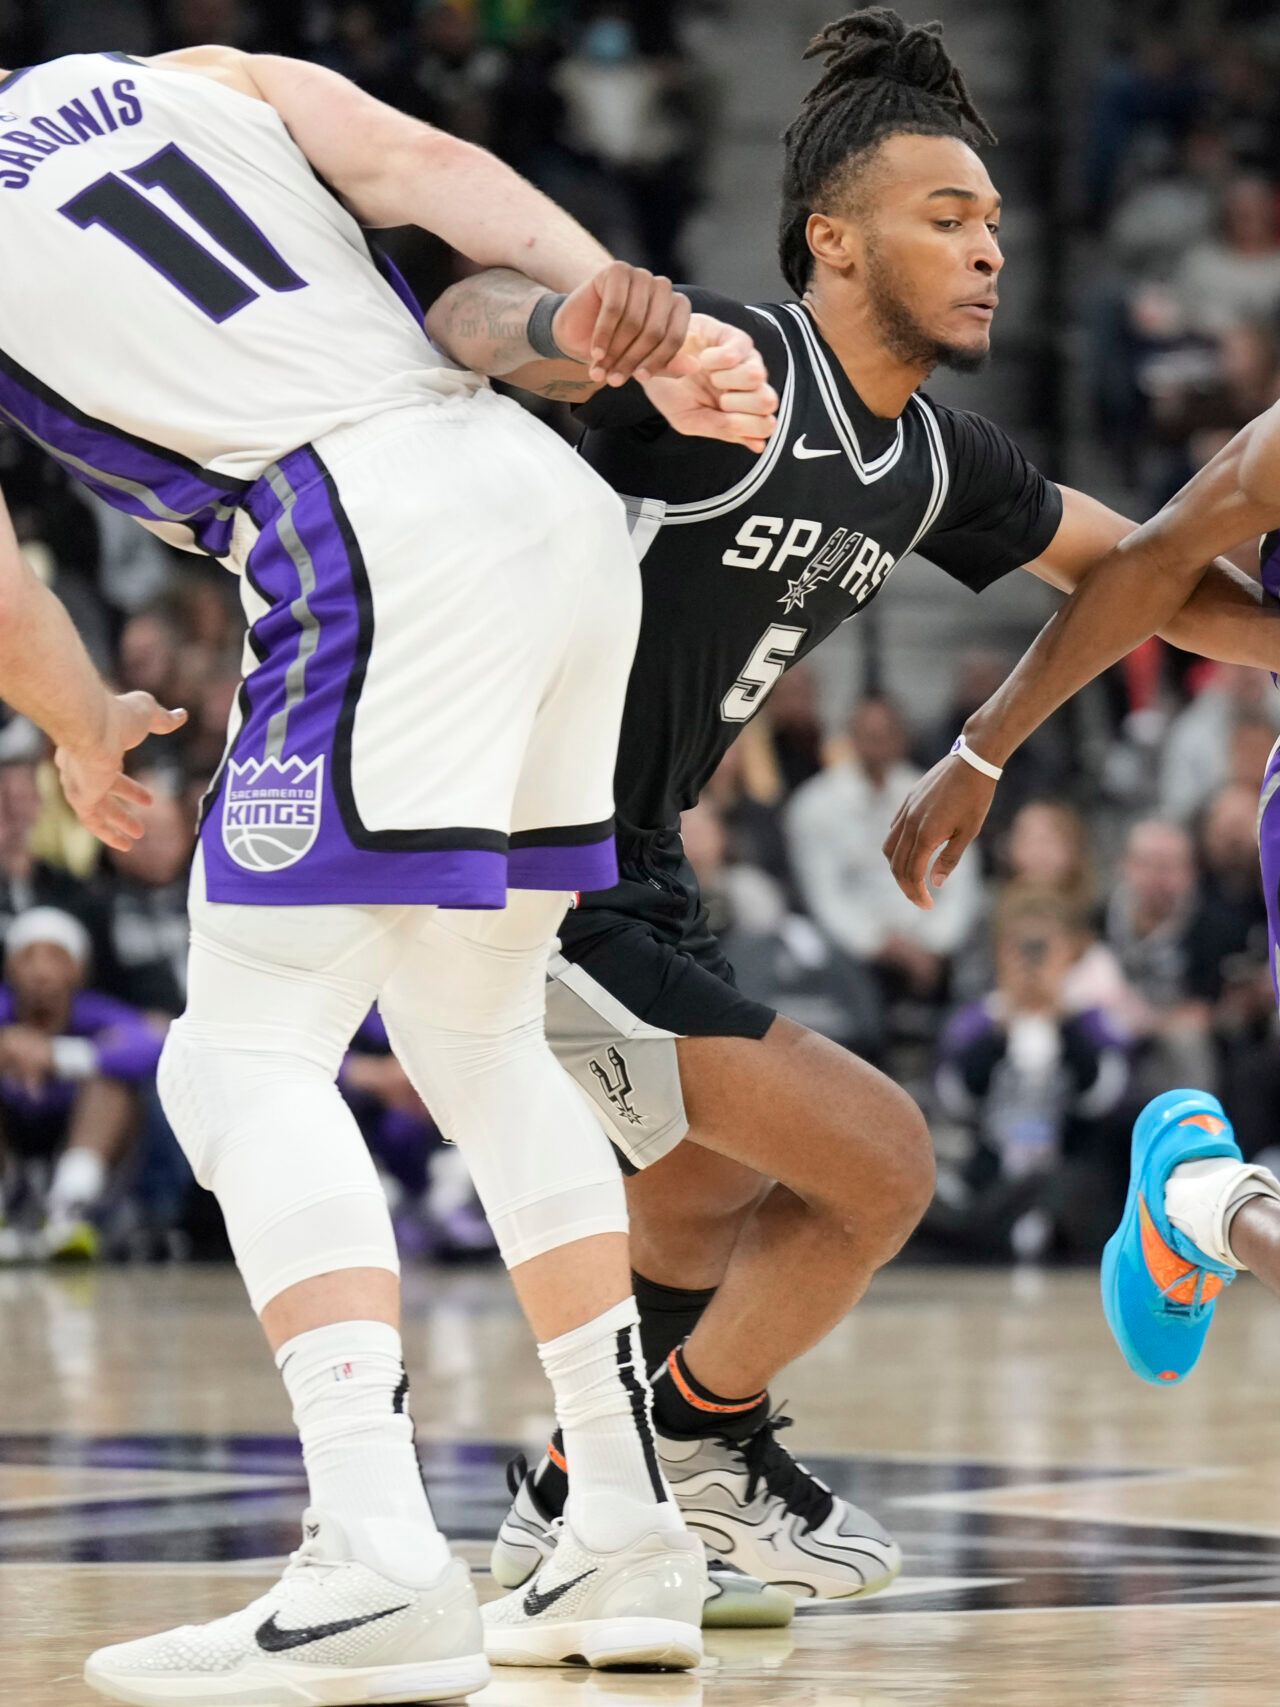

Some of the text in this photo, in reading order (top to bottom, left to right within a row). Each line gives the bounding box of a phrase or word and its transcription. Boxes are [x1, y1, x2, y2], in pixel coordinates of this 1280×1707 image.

[56, 141, 309, 324] 11
[722, 515, 895, 604] SPURS
[720, 623, 807, 722] 5
[227, 804, 315, 825] KINGS
[231, 789, 314, 800] SACRAMENTO
